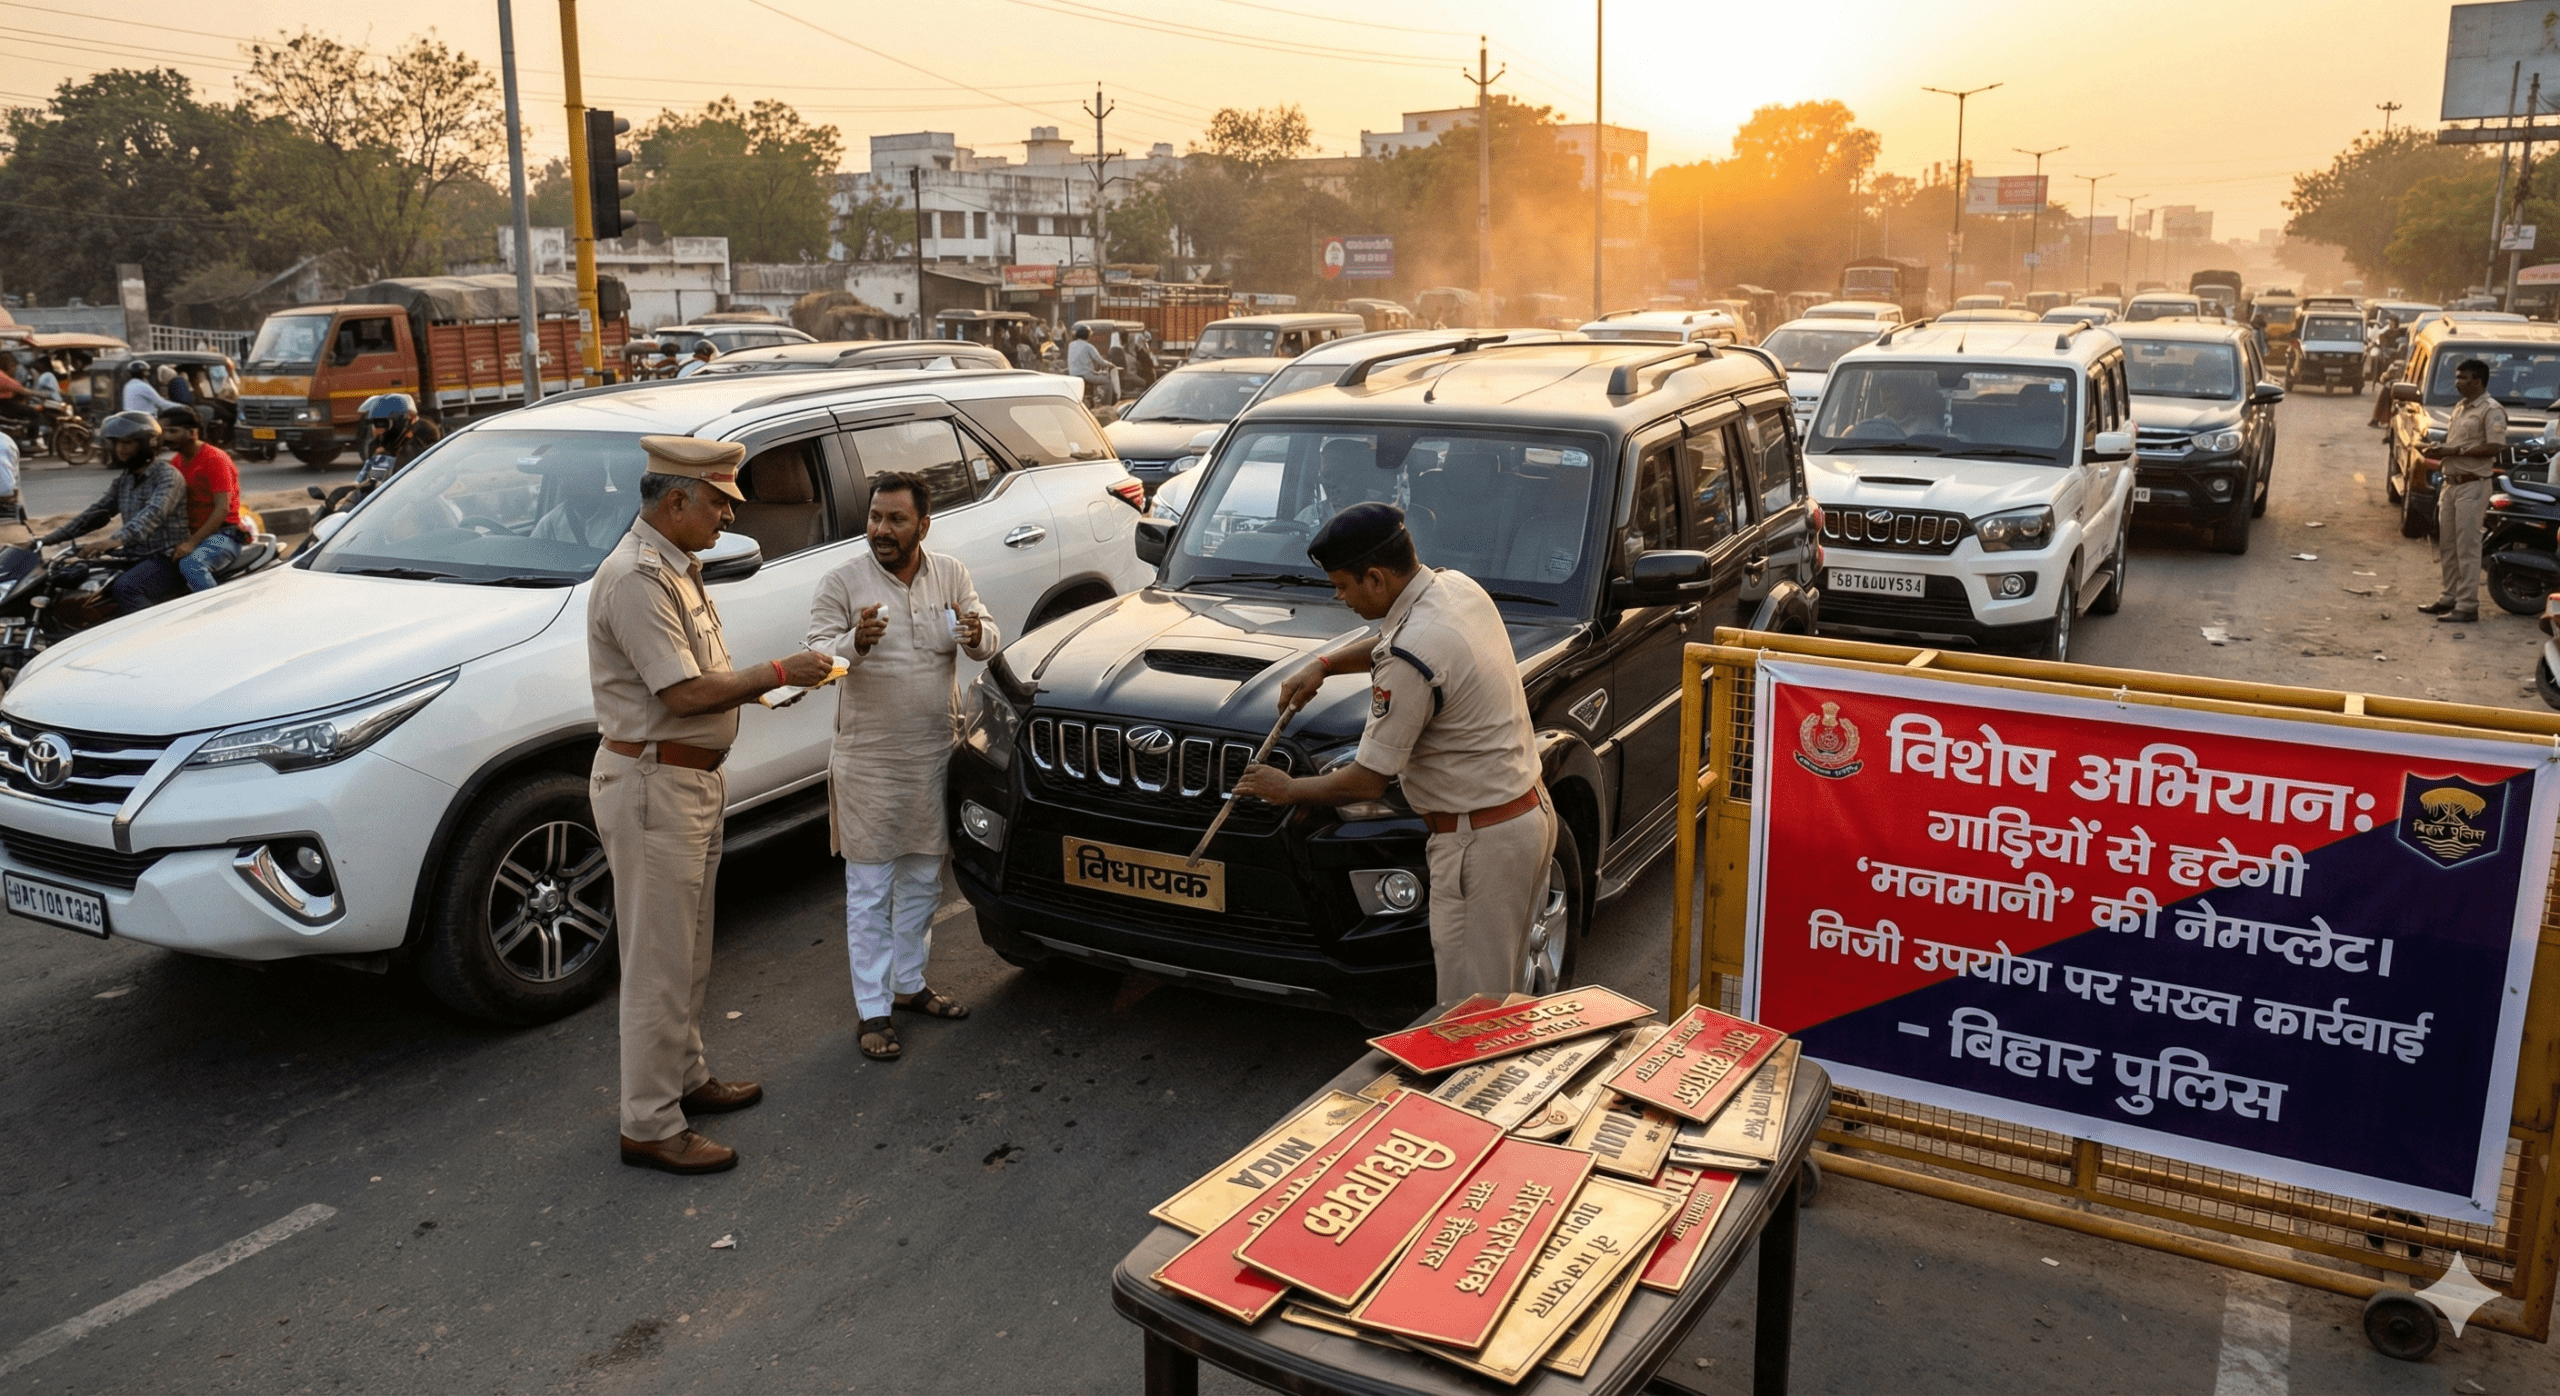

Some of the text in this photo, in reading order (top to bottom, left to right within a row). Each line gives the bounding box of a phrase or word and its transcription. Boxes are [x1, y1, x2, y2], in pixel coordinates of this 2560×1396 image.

[1886, 713, 2056, 792] विशेष
[1076, 845, 1211, 898] विधायक
[1928, 806, 2309, 897] गाड़ियों से हटेगी
[2092, 887, 2162, 938] की
[1809, 909, 2433, 1063] निजी उपयोग पर सख्त कार्रवाई
[1949, 1008, 2101, 1084] बिहार
[2113, 1047, 2288, 1121] पुलिस
[1303, 1128, 1457, 1246] विधायक
